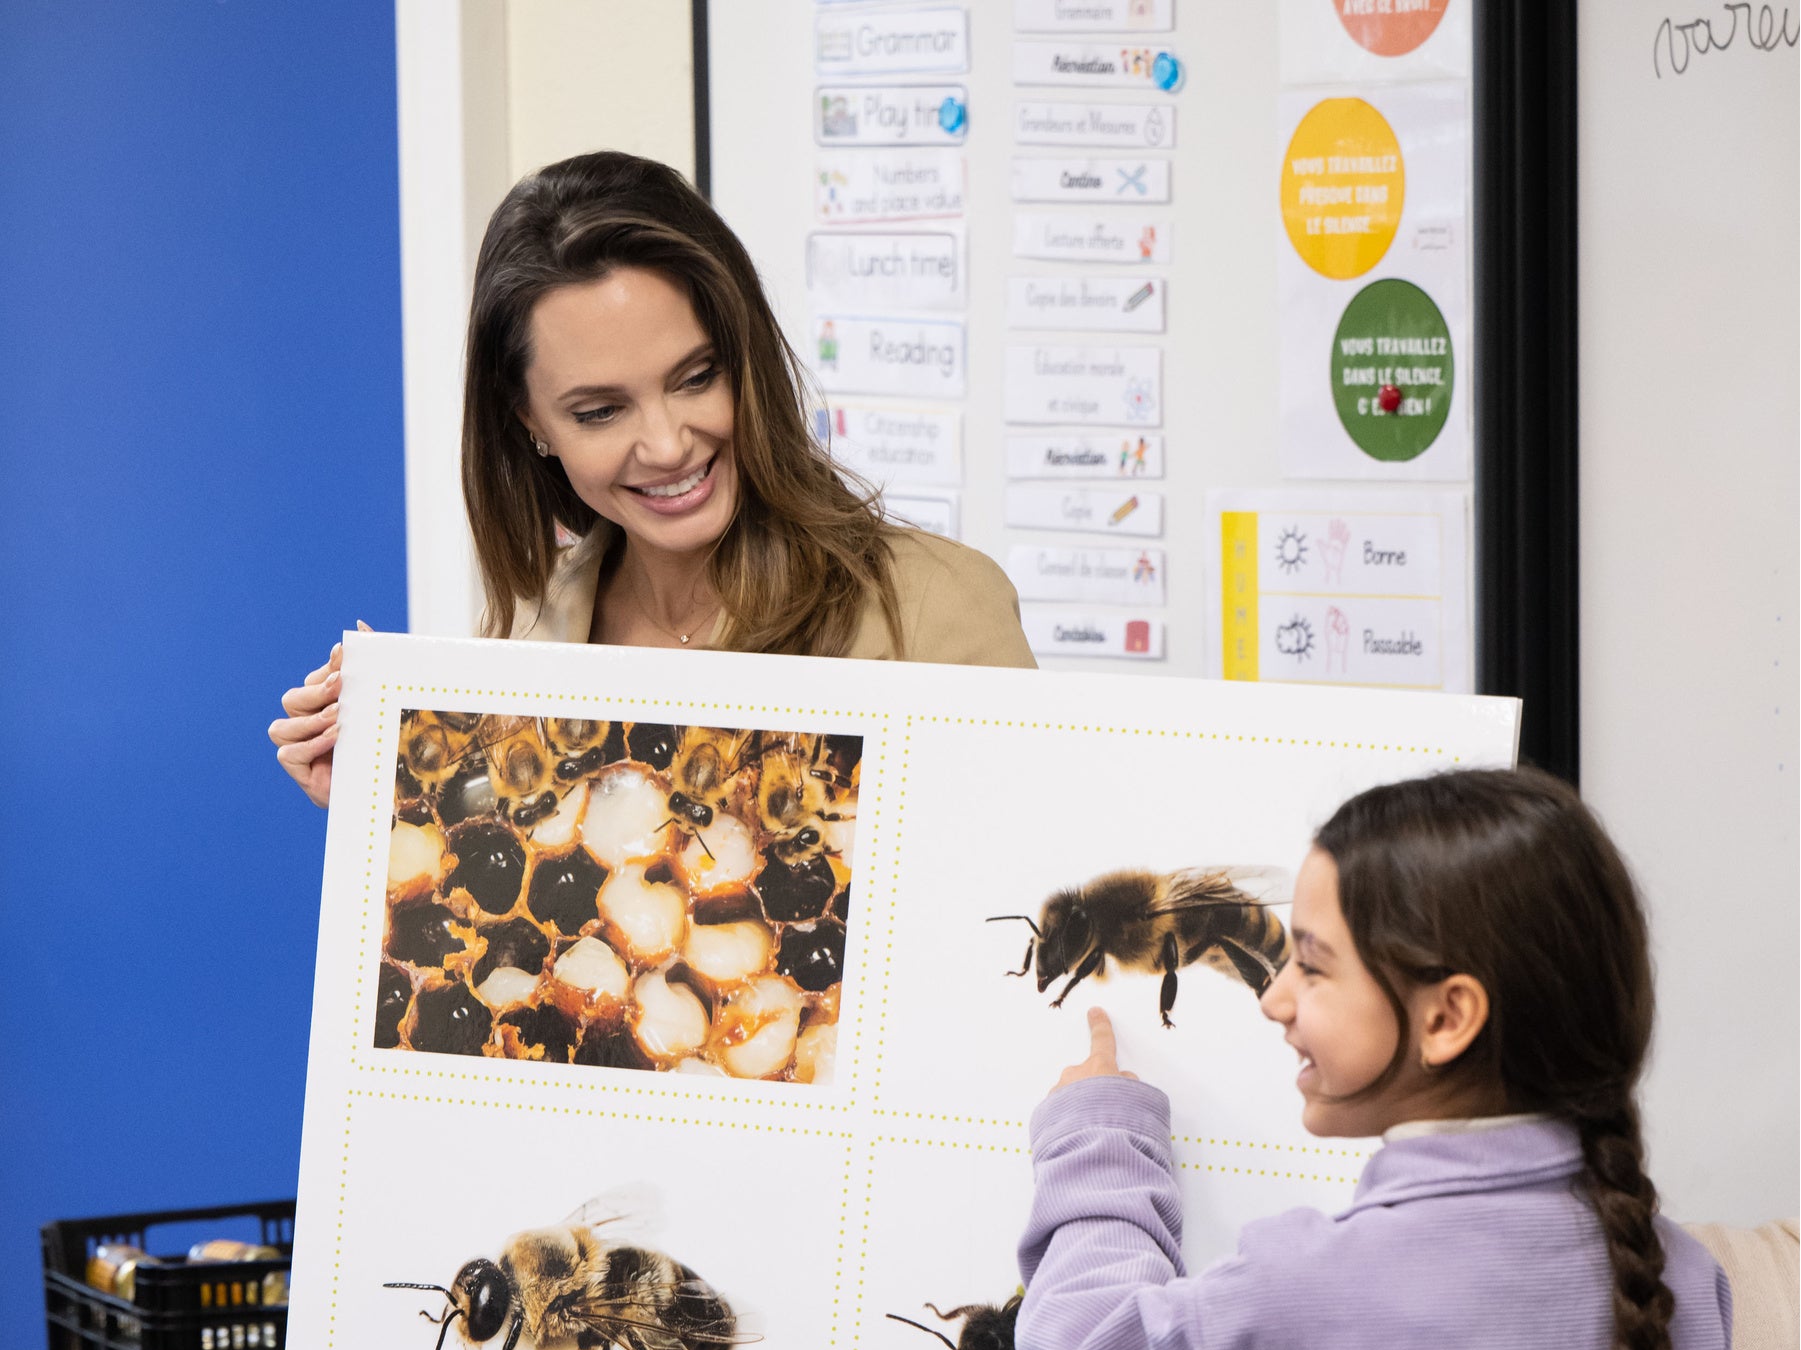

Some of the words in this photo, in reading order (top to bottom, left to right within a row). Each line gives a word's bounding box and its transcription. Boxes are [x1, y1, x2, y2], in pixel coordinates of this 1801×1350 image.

[857, 25, 957, 56] Grammar
[864, 96, 907, 137] Play
[873, 162, 940, 184] Numbers
[1292, 157, 1324, 175] VOUS
[1327, 155, 1397, 174] TRAVAILLEZ
[1306, 217, 1321, 235] LE
[849, 242, 904, 277] Lunch
[910, 246, 953, 278] time
[870, 330, 954, 377] Reading
[1341, 337, 1374, 356] VOUS
[1377, 337, 1447, 356] TRAVAILLEZ
[1343, 366, 1375, 385] DANS
[1377, 367, 1391, 385] LE
[1363, 540, 1407, 566] Bonne
[1363, 628, 1424, 656] Passable
